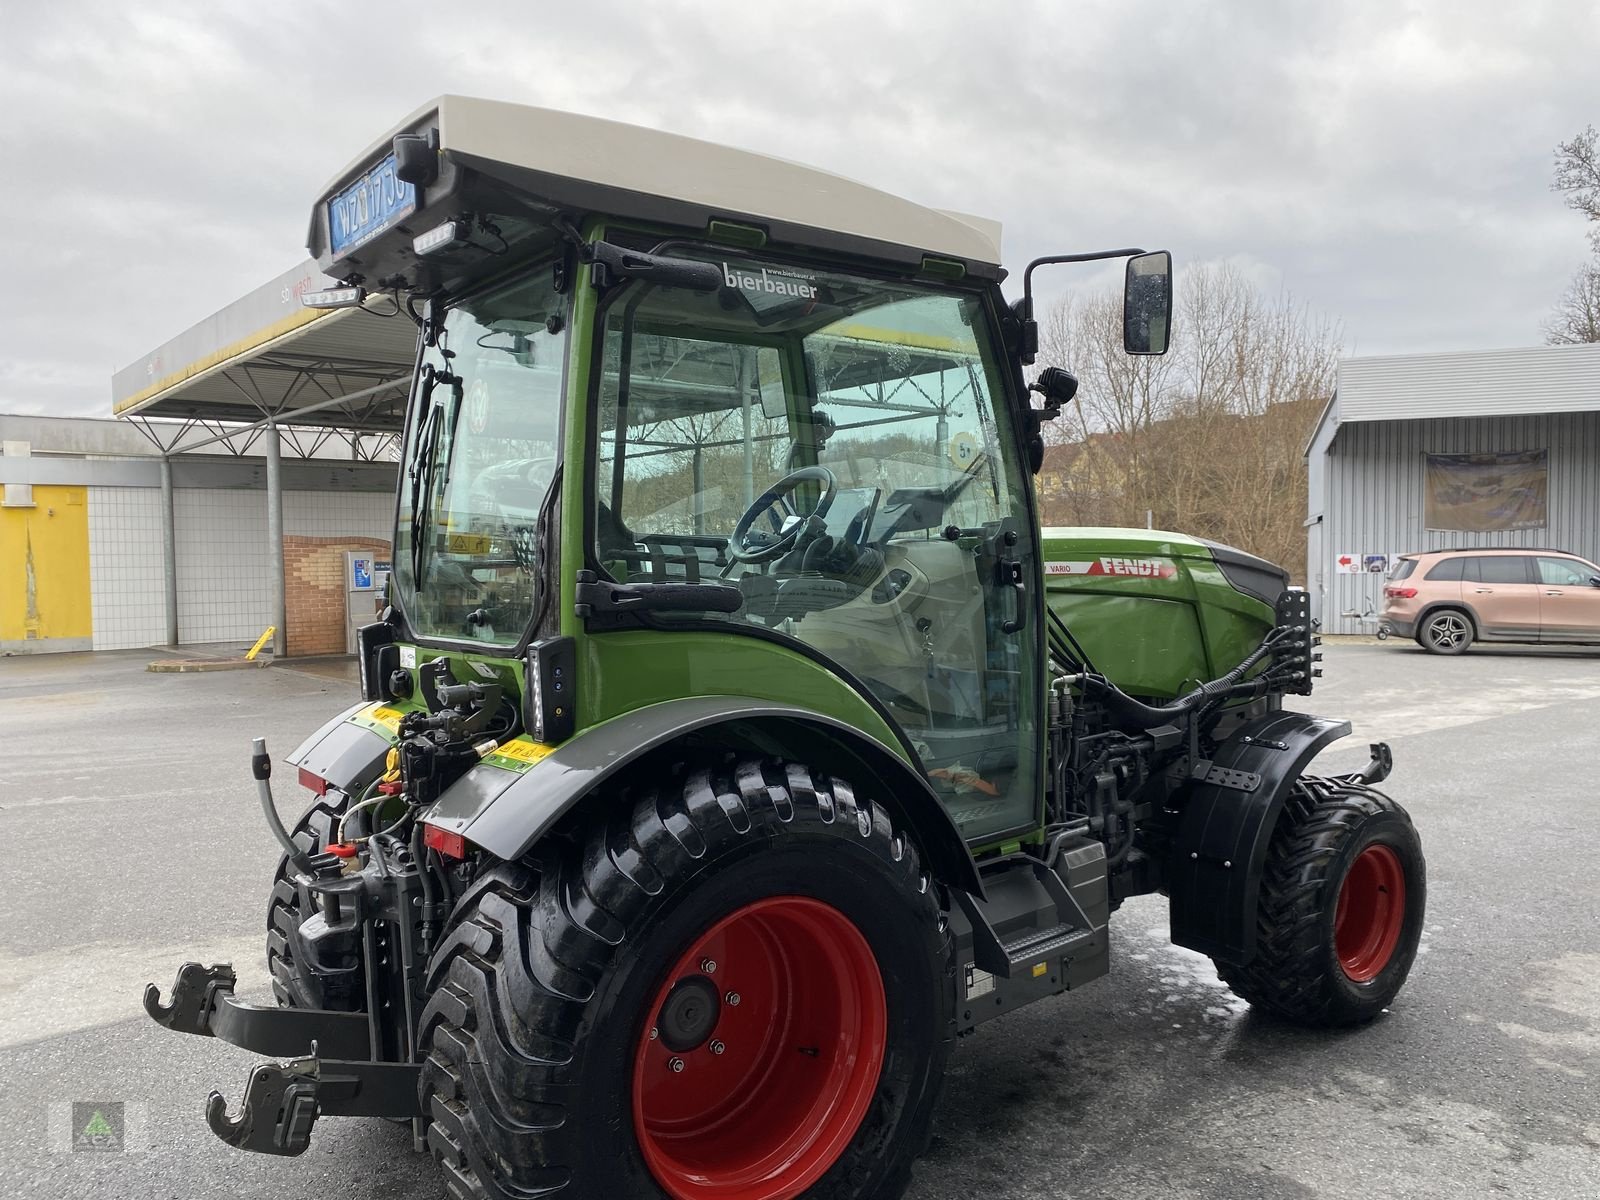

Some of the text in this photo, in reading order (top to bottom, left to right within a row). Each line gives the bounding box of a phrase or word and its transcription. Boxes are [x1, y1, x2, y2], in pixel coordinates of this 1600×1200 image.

[338, 194, 359, 239] WZ
[722, 261, 818, 299] bierbauer
[766, 267, 816, 281] www.bierbauer.at
[1050, 564, 1071, 573] VARIO
[1099, 556, 1162, 577] FENDT
